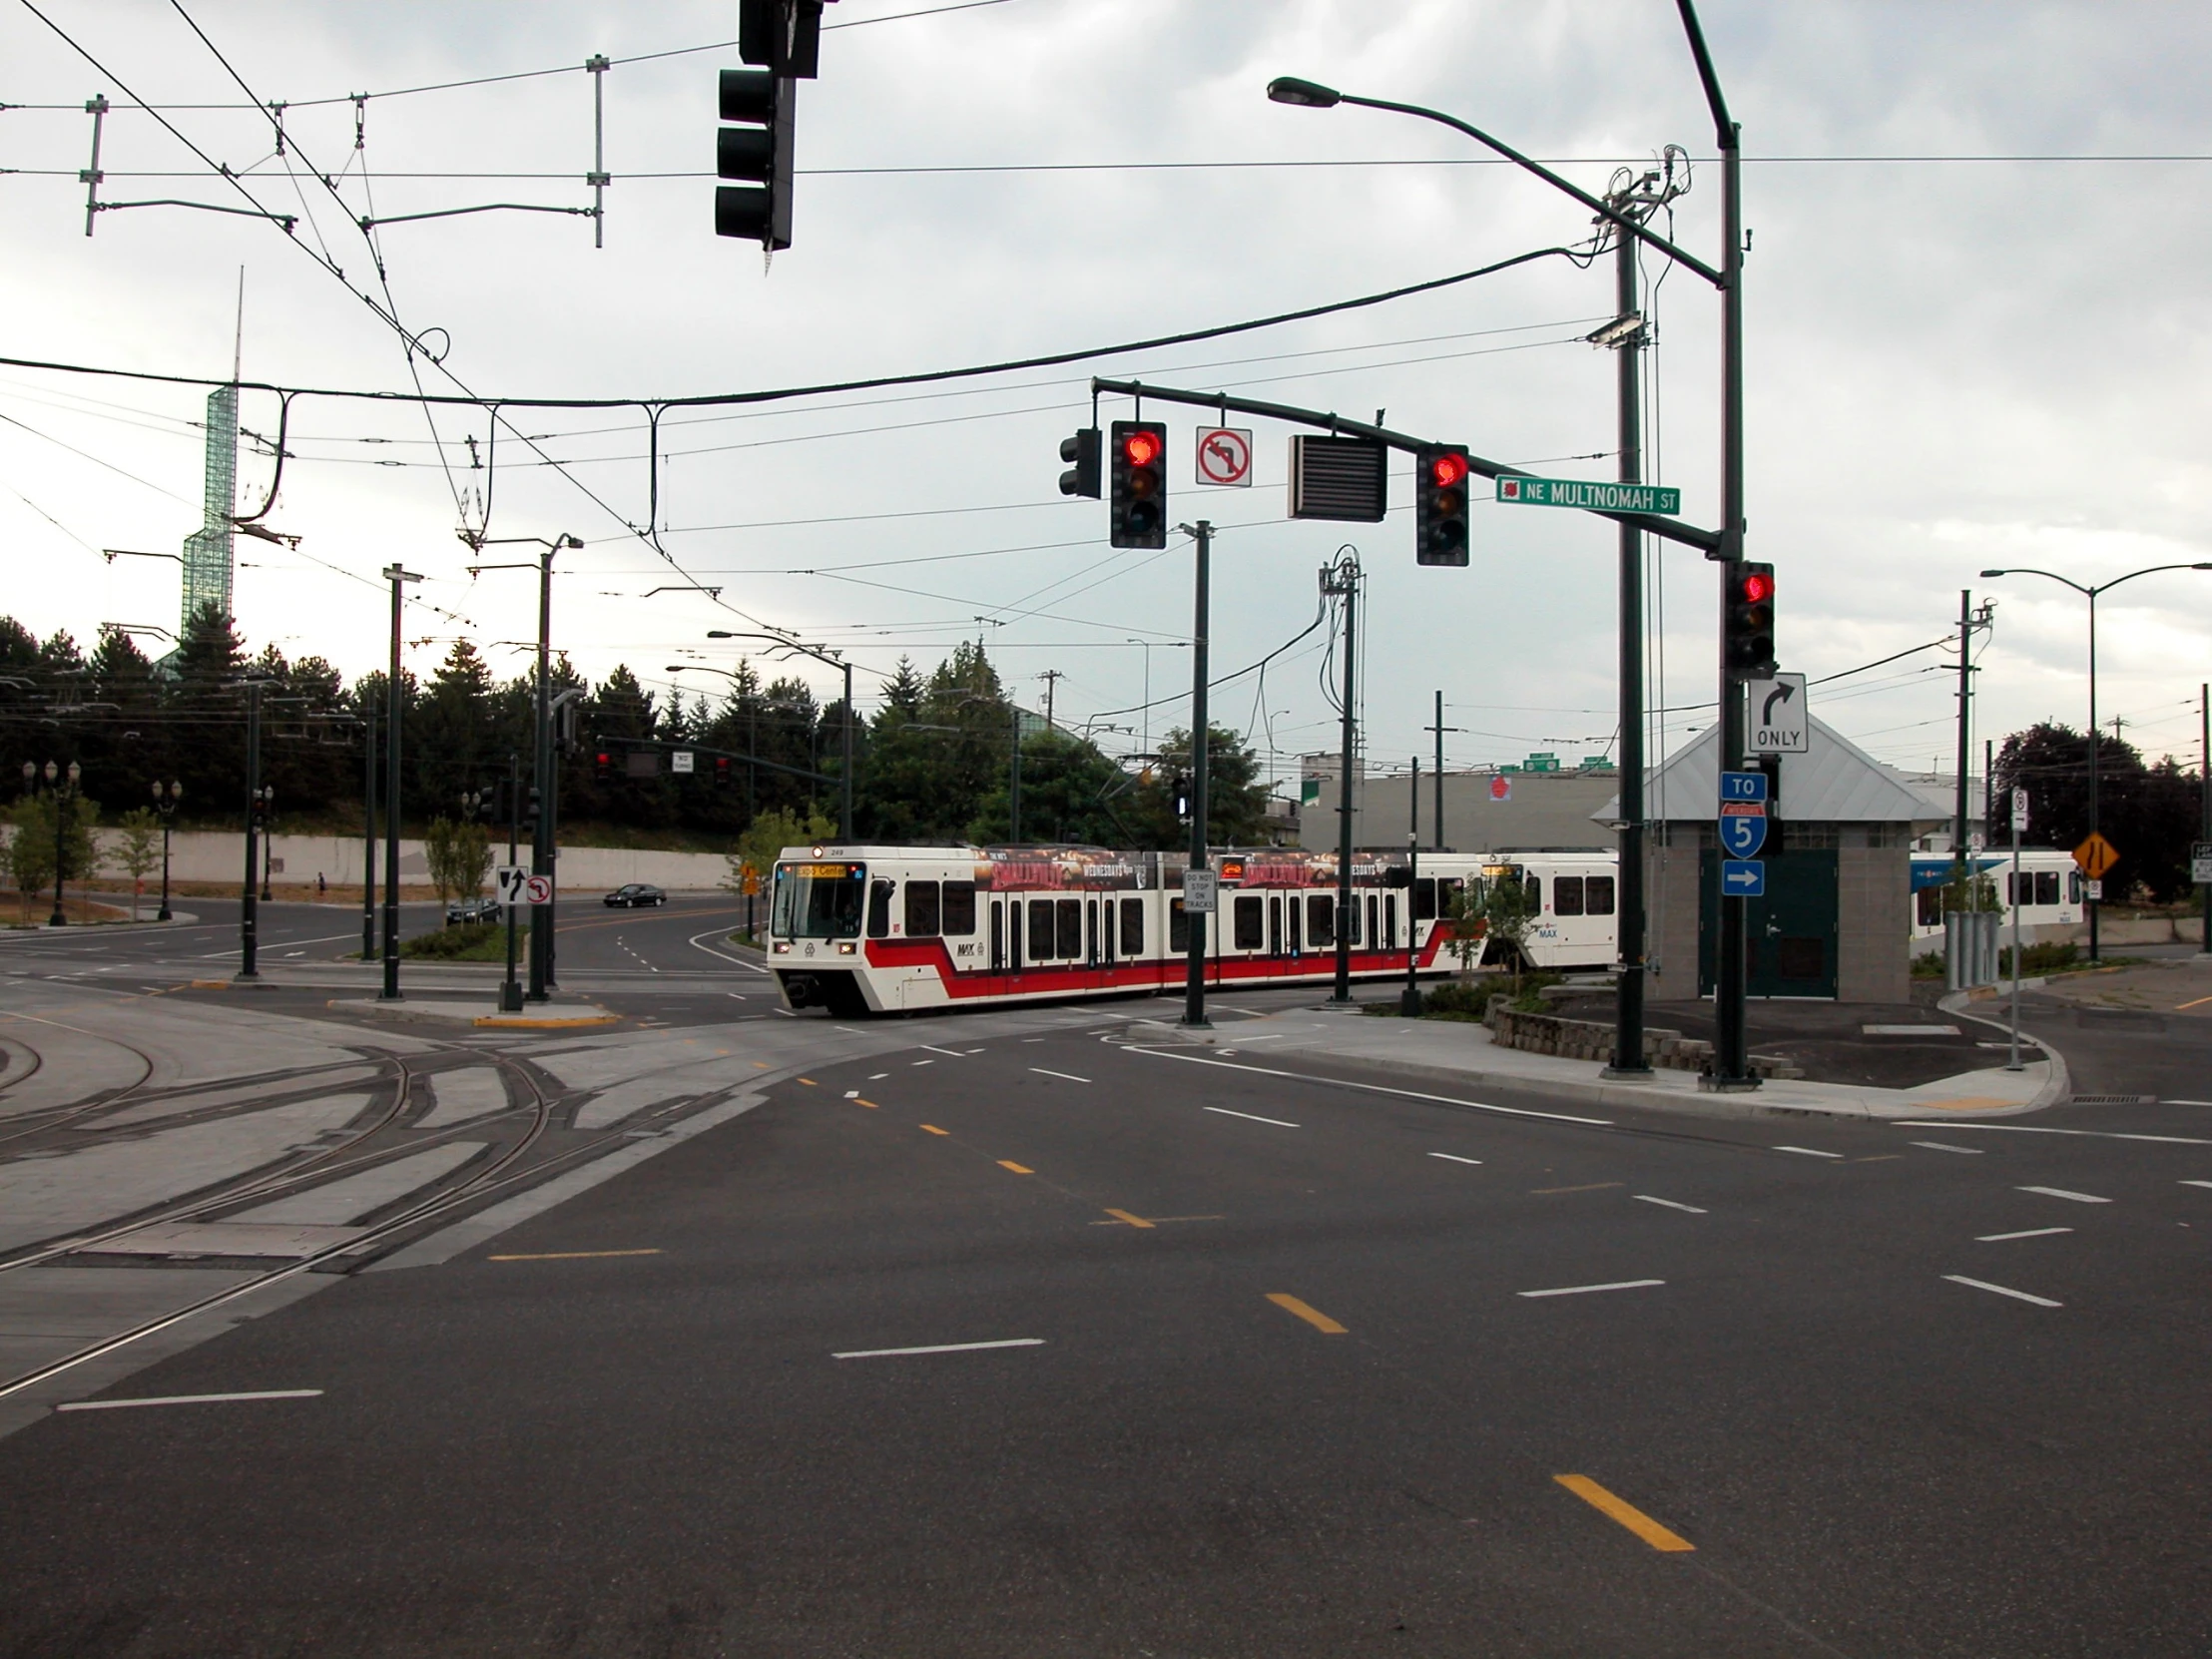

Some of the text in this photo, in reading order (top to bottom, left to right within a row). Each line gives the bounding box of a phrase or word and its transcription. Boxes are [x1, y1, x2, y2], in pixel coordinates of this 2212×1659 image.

[1526, 483, 1675, 510] NE MULTNOMAH ST
[1758, 730, 1800, 746] ONLY
[1733, 779, 1755, 795] TO
[1727, 807, 1760, 816] INTERSTATE
[1735, 818, 1753, 848] 5
[819, 865, 846, 875] Center
[1083, 864, 1122, 877] WEDNESDAYS
